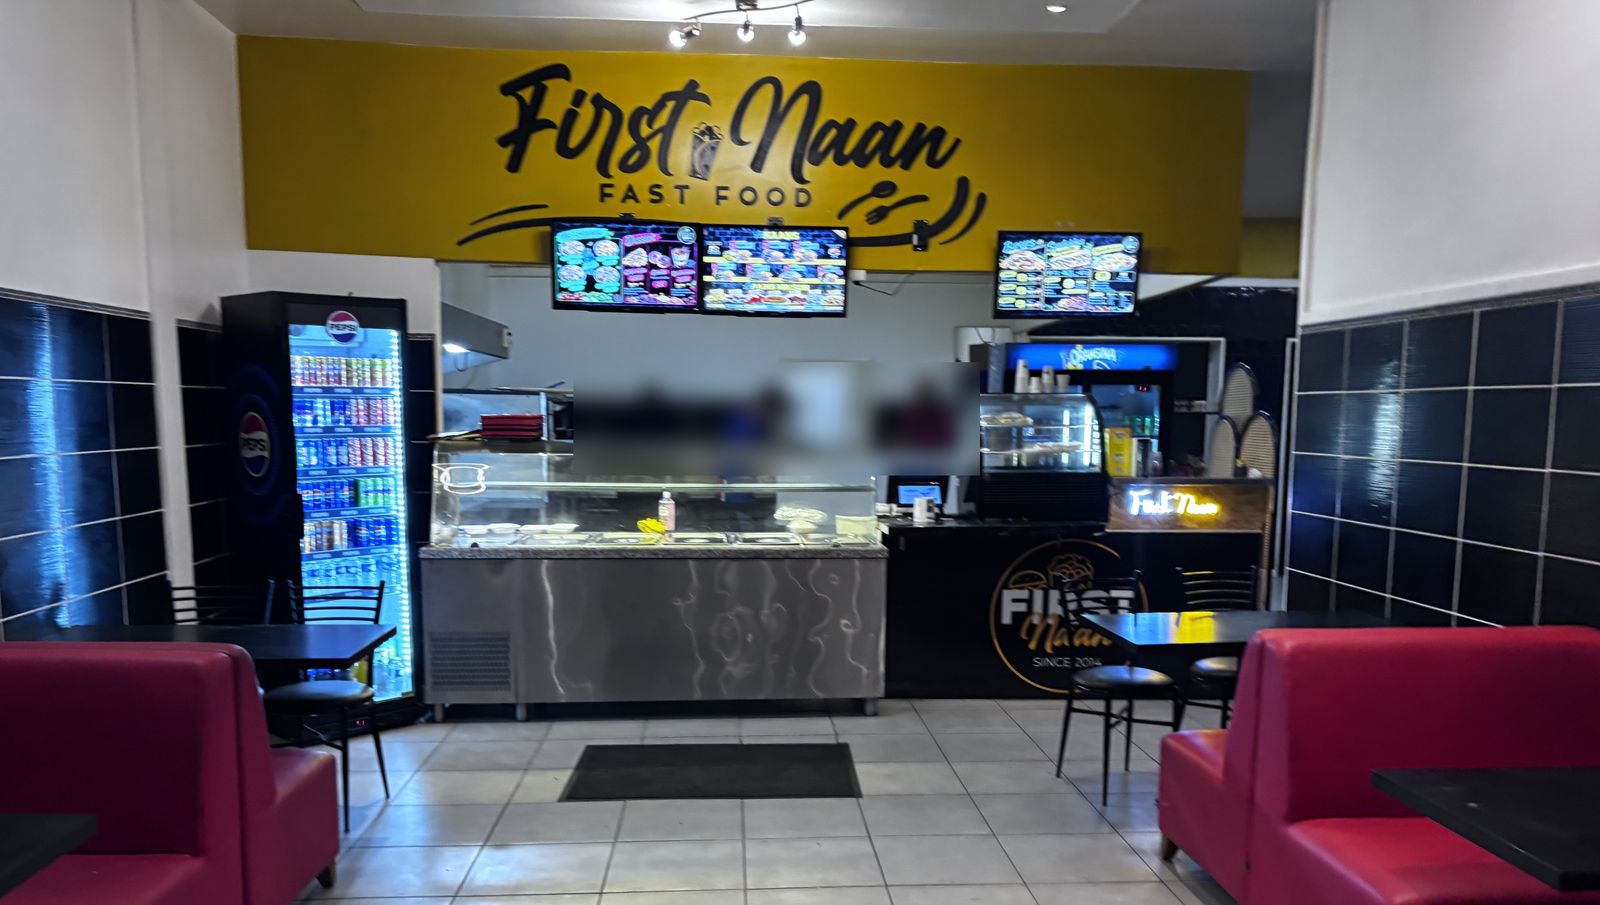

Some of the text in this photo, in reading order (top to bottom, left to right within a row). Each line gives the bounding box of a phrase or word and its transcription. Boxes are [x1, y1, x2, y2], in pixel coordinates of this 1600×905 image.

[496, 63, 961, 184] First Naan
[600, 184, 812, 207] FAST FOOD
[330, 323, 356, 332] PEPSI
[1033, 657, 1071, 667] SINCE
